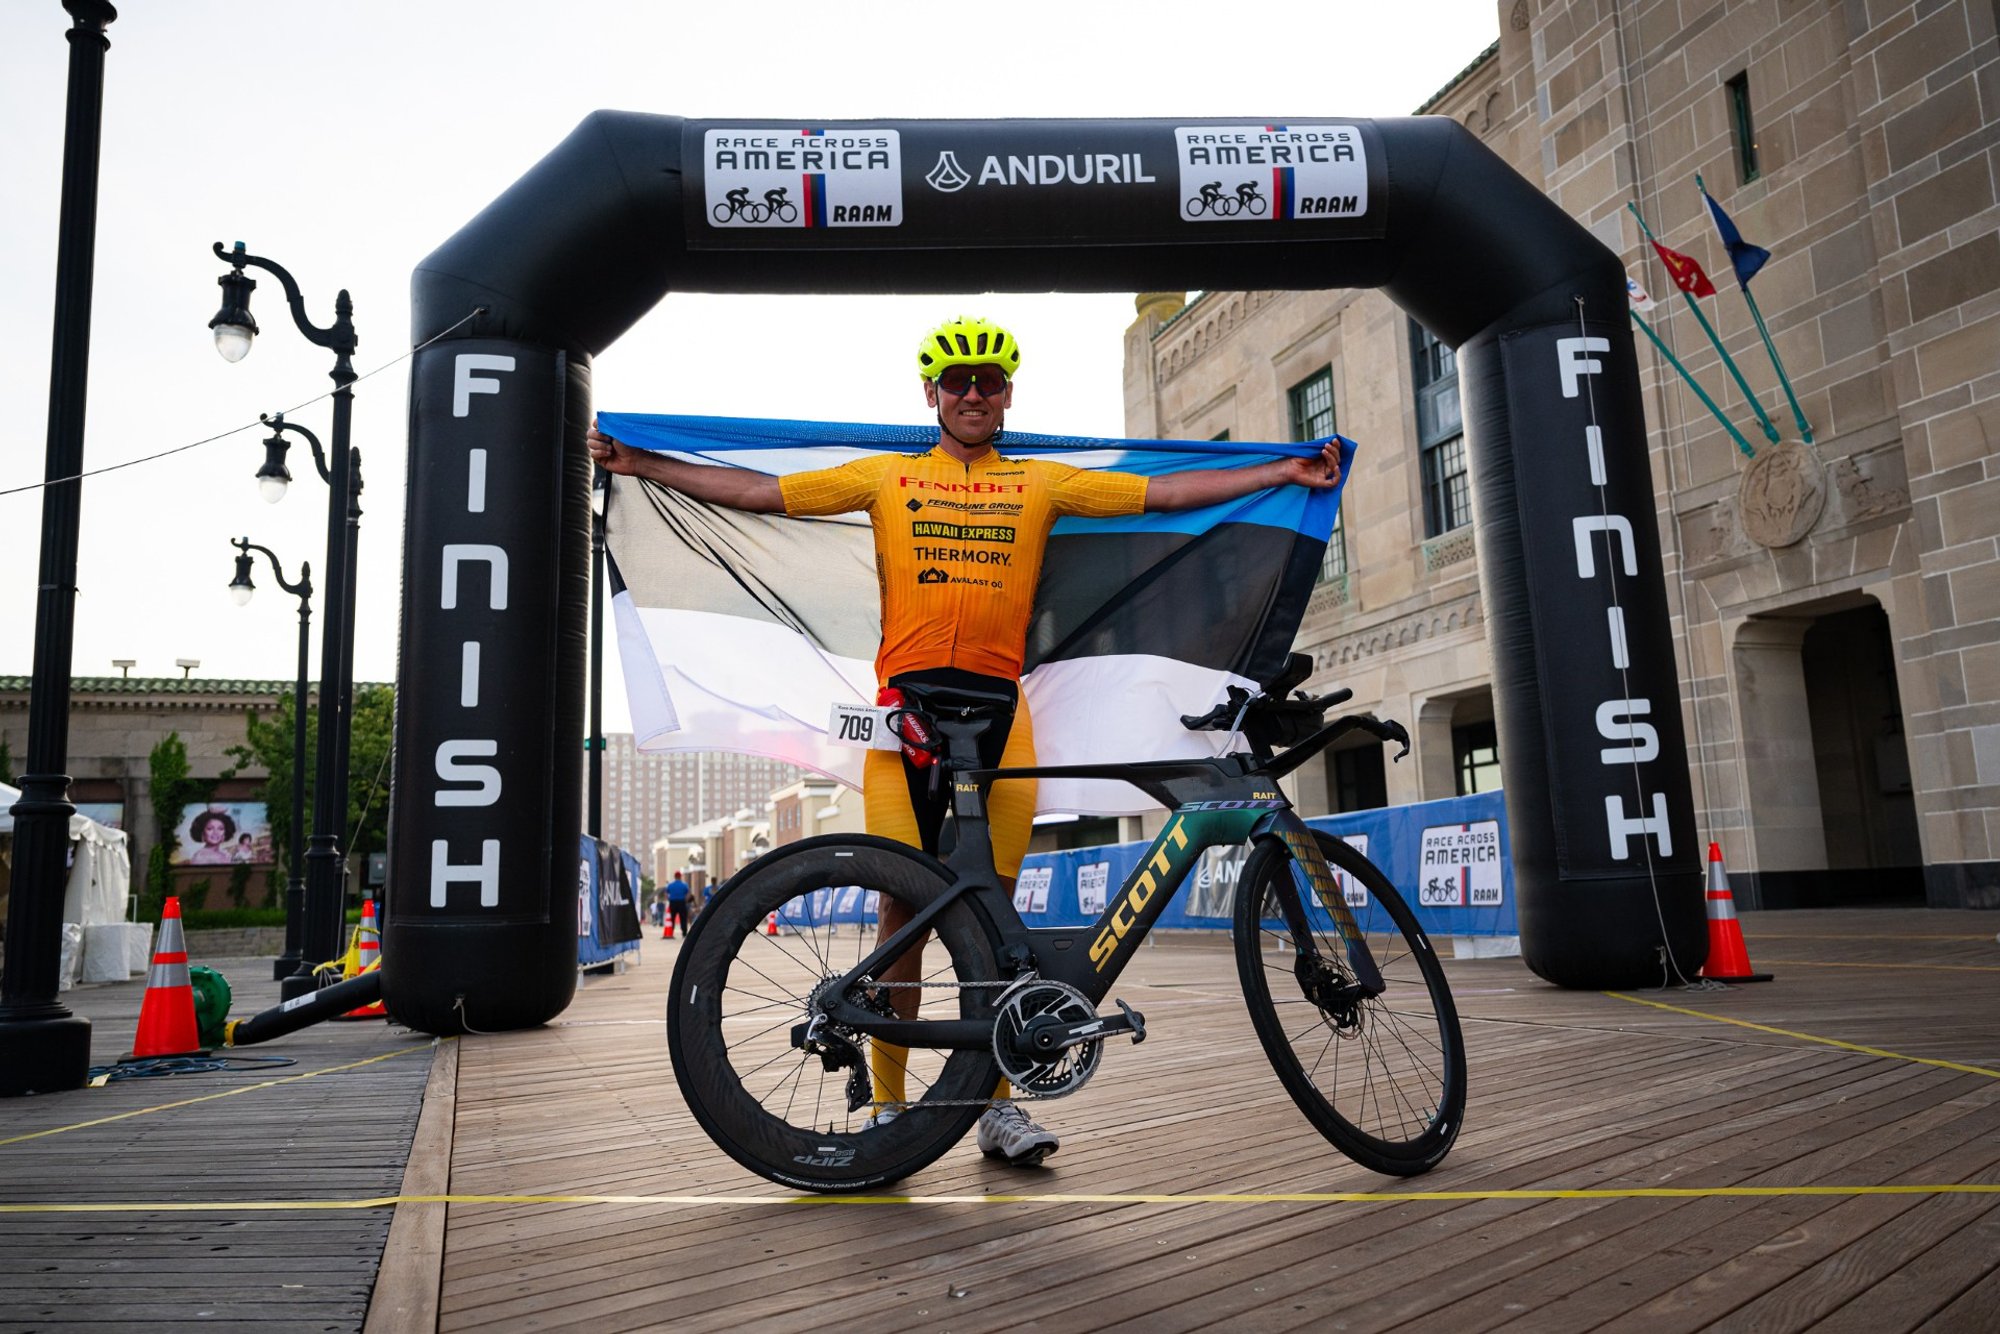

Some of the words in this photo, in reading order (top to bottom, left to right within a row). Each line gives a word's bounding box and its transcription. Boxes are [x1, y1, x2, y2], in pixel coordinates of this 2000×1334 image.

[716, 138, 778, 148] RACE
[792, 138, 888, 148] ACROSS
[1187, 134, 1247, 144] RACE
[1259, 133, 1351, 143] ACROSS
[716, 151, 889, 170] AMERICA
[1189, 144, 1355, 165] AMERICA
[978, 153, 1156, 185] ANDURIL
[833, 205, 892, 222] RAAM
[1301, 196, 1357, 214] RAAM
[927, 499, 986, 510] FERROLINE
[988, 502, 1024, 511] GROUP
[915, 523, 958, 537] HAWAII
[962, 527, 1014, 541] EXPRESS
[950, 577, 989, 586] AVALAST
[1556, 337, 1673, 860] FINISH
[430, 353, 516, 907] FINISH
[838, 714, 874, 742] 709
[956, 783, 979, 792] RAIT
[1252, 791, 1276, 800] RAIT
[1176, 800, 1284, 813] SCOTT
[1426, 836, 1453, 847] RACE
[1457, 832, 1495, 845] ACROSS
[1425, 845, 1496, 865] AMERICA
[1089, 814, 1188, 973] SCOTT
[1473, 888, 1498, 901] RAAM
[793, 1155, 854, 1167] ZIPP
